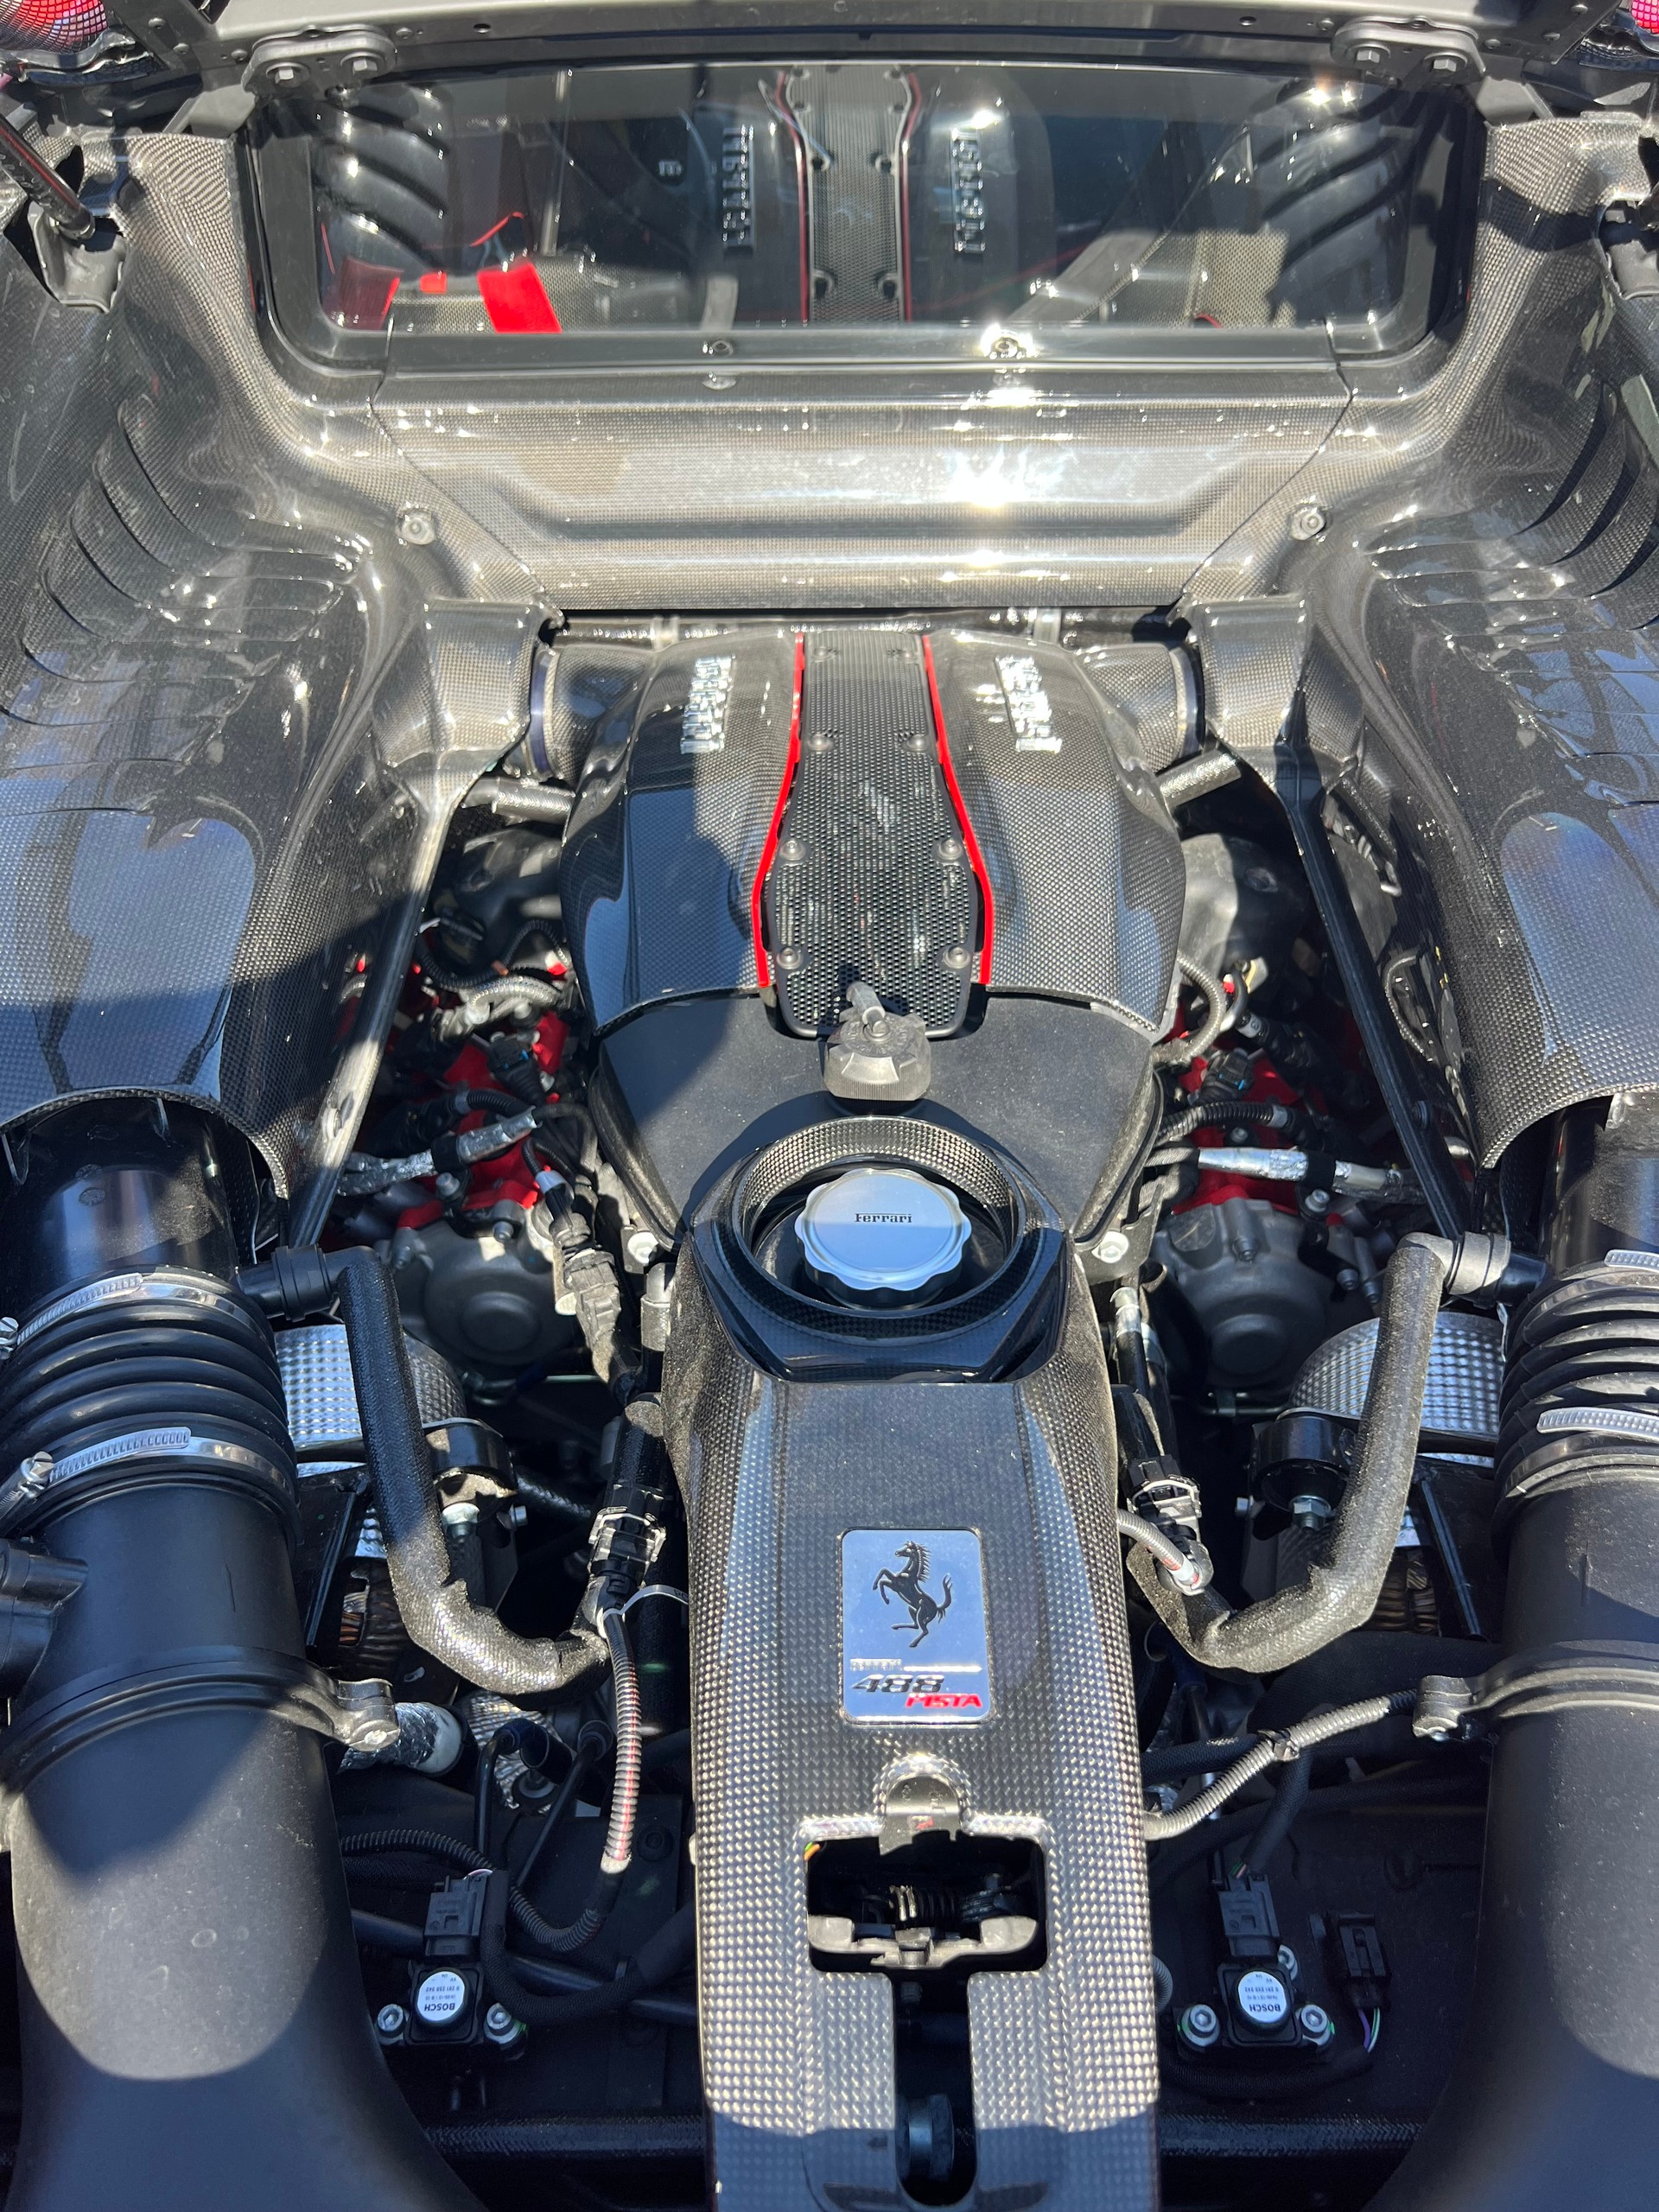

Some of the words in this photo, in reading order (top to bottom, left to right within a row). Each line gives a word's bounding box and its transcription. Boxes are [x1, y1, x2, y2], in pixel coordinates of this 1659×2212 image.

[855, 1212, 912, 1224] Ferrari
[851, 1674, 944, 1693] 488
[905, 1693, 982, 1708] PISTA
[423, 2003, 455, 2012] BOSCH
[1249, 2004, 1281, 2012] BOSCH
